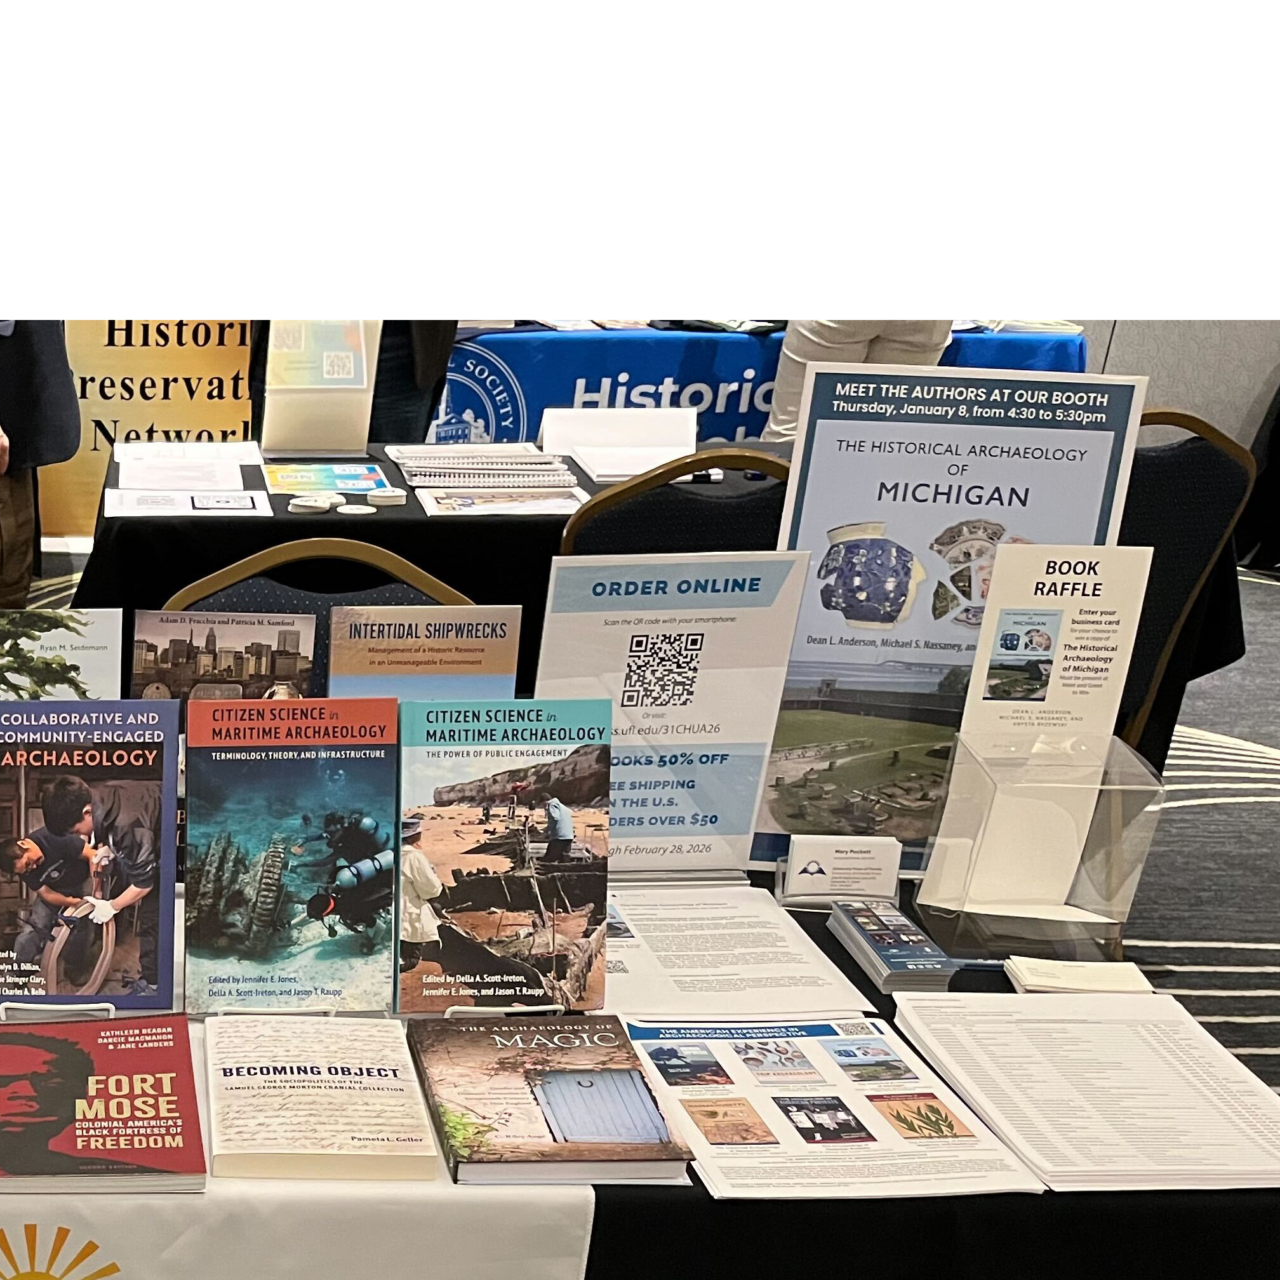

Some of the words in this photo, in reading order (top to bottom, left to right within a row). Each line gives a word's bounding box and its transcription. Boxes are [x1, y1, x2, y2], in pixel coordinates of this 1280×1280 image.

[465, 358, 514, 430] SOCIETY
[835, 383, 877, 397] MEET
[880, 384, 909, 398] THE
[911, 386, 986, 401] AUTHORS
[990, 389, 1011, 402] AT
[1014, 389, 1048, 404] OUR
[1052, 392, 1108, 407] BOOTH
[832, 400, 897, 416] Thursday,
[900, 403, 956, 418] January
[958, 405, 969, 418] 8,
[972, 406, 1004, 418] from
[1007, 407, 1036, 419] 4:30
[1039, 409, 1052, 420] to
[1055, 409, 1106, 423] 5:30pm
[836, 440, 866, 452] THE
[871, 441, 962, 456] HISTORICAL
[966, 444, 1088, 462] ARCHAEOLOGY
[947, 464, 969, 476] OF
[877, 482, 1030, 507] MICHIGAN
[1046, 560, 1100, 576] BOOK
[592, 580, 668, 597] ORDER
[676, 577, 761, 594] ONLINE
[1034, 582, 1102, 597] RAFFLE
[349, 623, 420, 639] INTERTIDAL
[425, 622, 507, 639] SHIPWRECKS
[40, 644, 57, 652] Ryan
[1, 713, 123, 725] COLLABORATIVE
[126, 713, 159, 724] AND
[212, 709, 265, 721] CITIZEN
[270, 708, 325, 720] SCIENCE
[329, 711, 339, 720] in
[426, 710, 481, 723] CITIZEN
[485, 709, 543, 723] SCIENCE
[546, 713, 557, 721] in
[212, 726, 280, 740] MARITIME
[285, 725, 386, 739] ARCHAEOLOGY
[426, 729, 497, 742] MARITIME
[501, 727, 605, 741] ARCHAEOLOGY
[1, 750, 157, 766] ARCHAEOLOGY
[657, 753, 694, 768] 50%
[699, 754, 729, 765] OFF
[629, 780, 696, 791] SHIPPING
[621, 798, 648, 808] THE
[652, 797, 678, 807] U.S.
[648, 816, 686, 826] OVER
[690, 813, 718, 826] $50
[623, 845, 668, 855] February
[672, 844, 685, 855] 28,
[687, 844, 712, 853] 2026
[490, 1033, 620, 1049] MAGIC
[222, 1066, 321, 1077] BECOMING
[328, 1066, 399, 1078] OBJECT
[88, 1073, 176, 1096] FORT
[75, 1096, 180, 1120] MOSE
[75, 1120, 124, 1128] COLONIAL
[128, 1119, 183, 1127] AMERICA'S
[76, 1128, 109, 1136] BLACK
[113, 1127, 166, 1135] FORTRESS
[76, 1136, 184, 1149] FREEDOM
